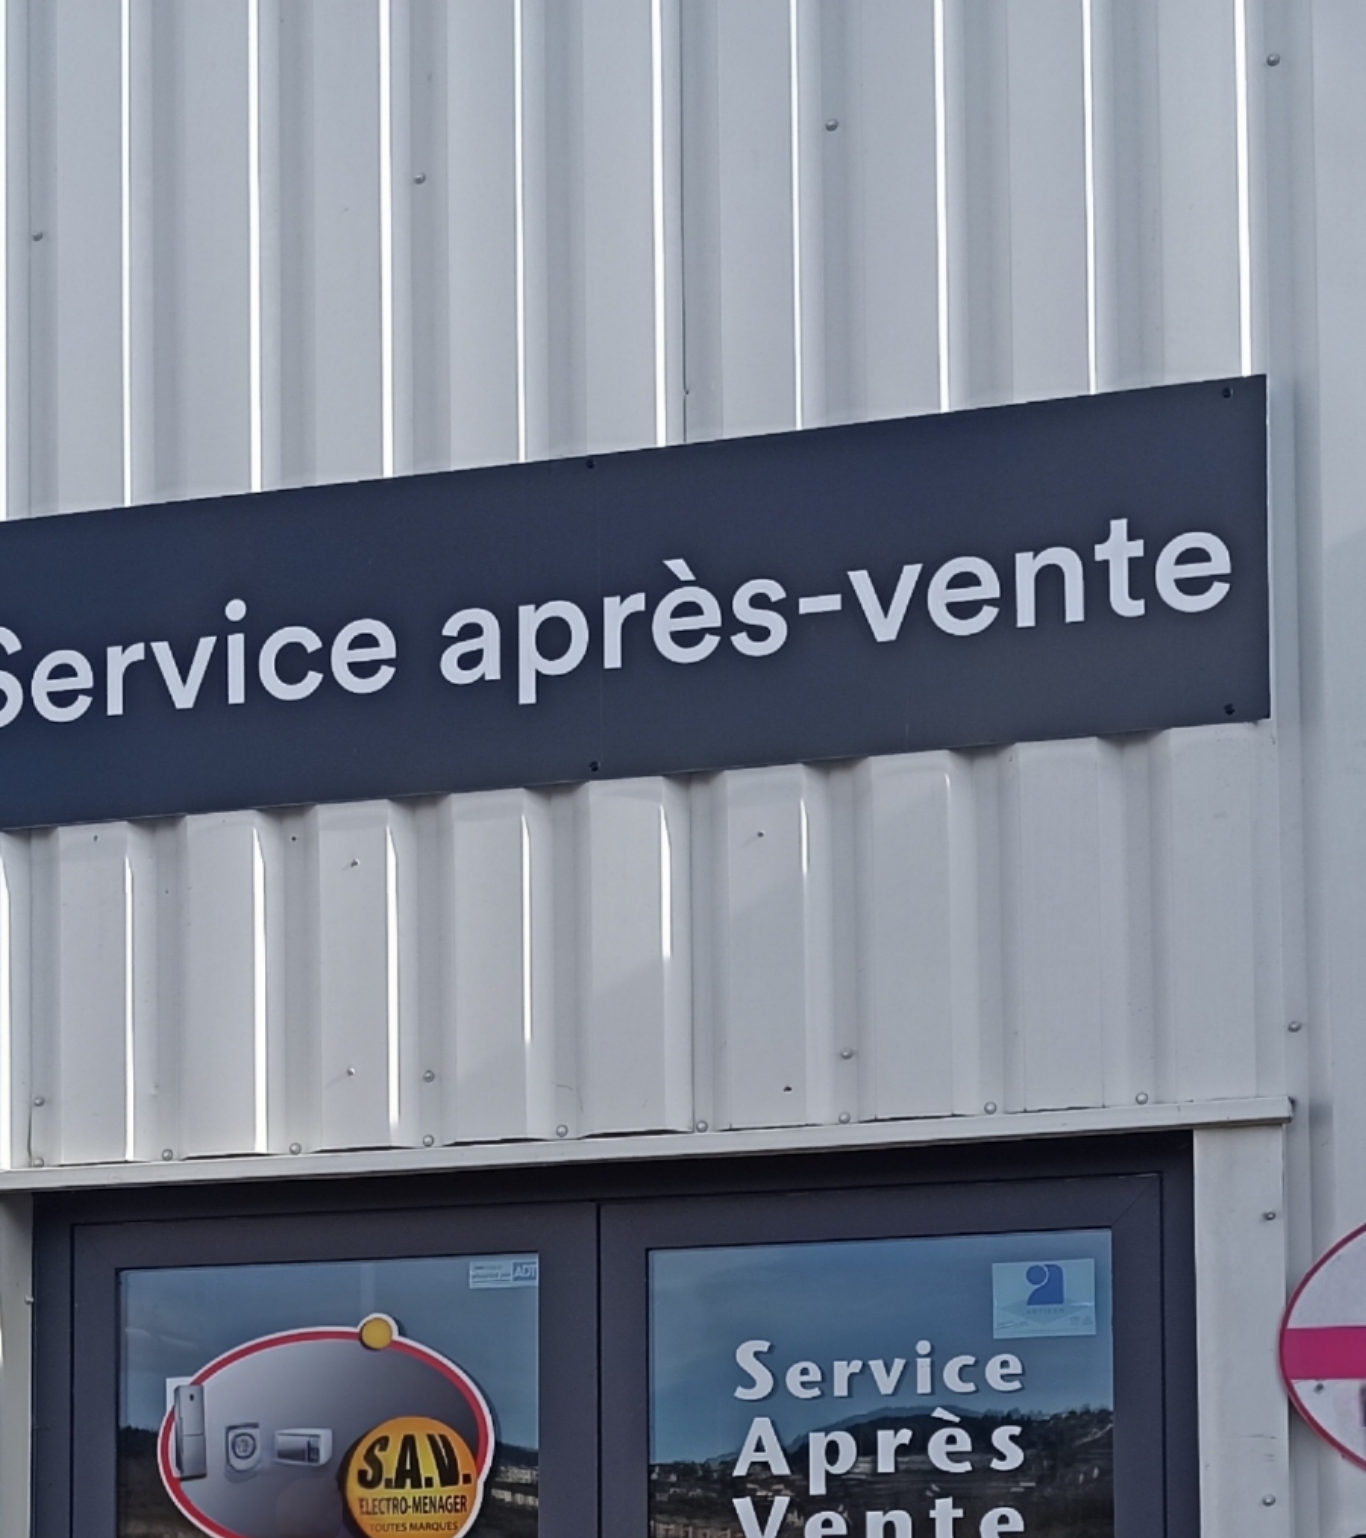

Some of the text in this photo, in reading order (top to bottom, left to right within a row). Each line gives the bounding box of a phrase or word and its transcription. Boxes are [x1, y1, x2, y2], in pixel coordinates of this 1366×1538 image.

[439, 518, 1232, 704] après-vente
[734, 1339, 1025, 1401] Service
[357, 1433, 473, 1490] S.A.V.
[732, 1407, 1026, 1496] Après
[358, 1494, 469, 1515] ELECTRO-MENAGER
[371, 1520, 460, 1533] TOUTES MARQUES
